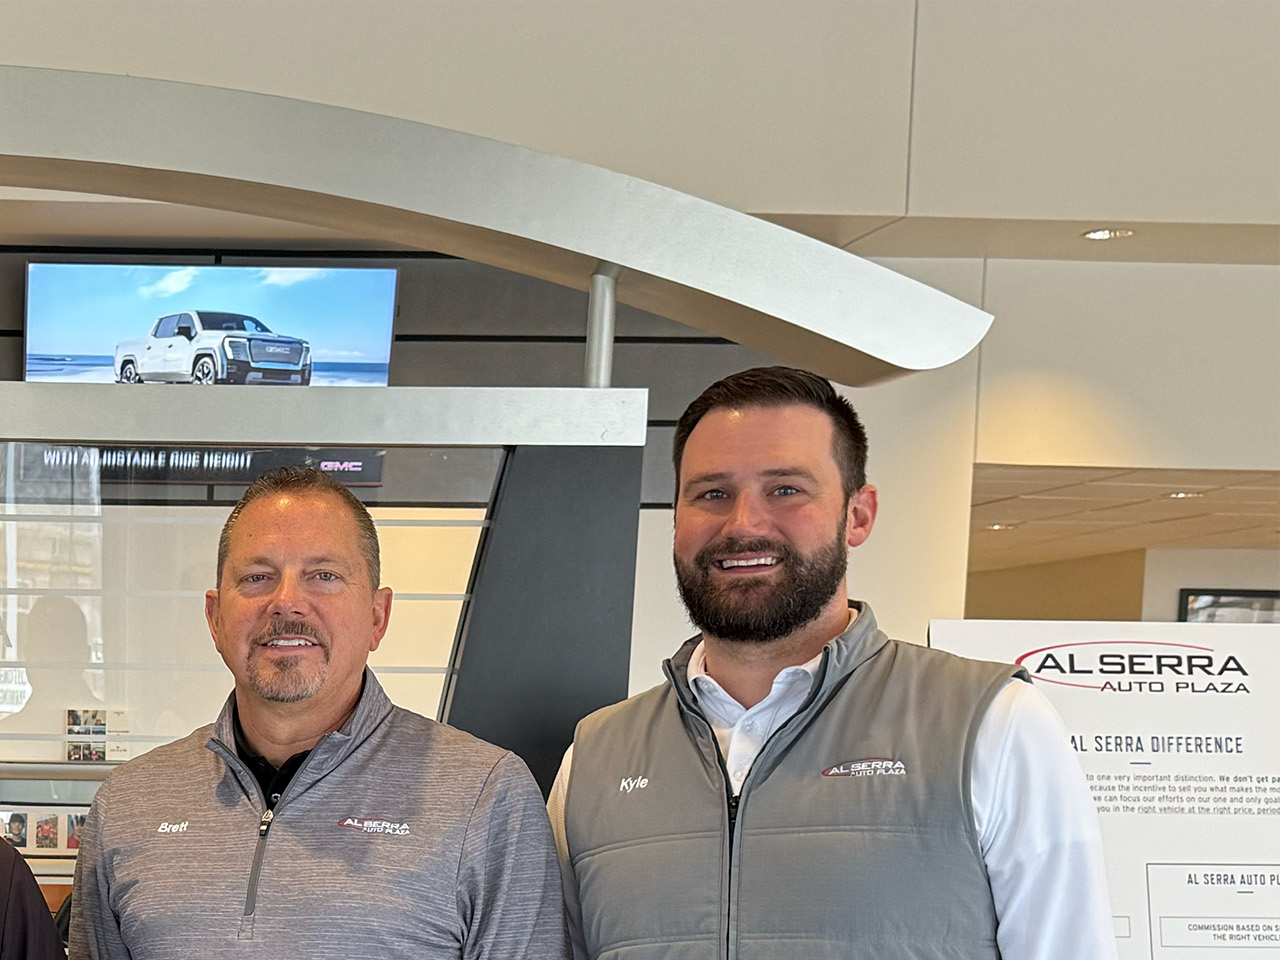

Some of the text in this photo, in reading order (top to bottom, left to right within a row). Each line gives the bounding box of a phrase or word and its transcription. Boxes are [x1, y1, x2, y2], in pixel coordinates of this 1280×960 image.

[321, 461, 363, 471] GMC
[1035, 653, 1249, 676] AL SERRA
[1101, 681, 1250, 694] AUTO PLAZA
[1095, 735, 1144, 753] SERRA
[1151, 736, 1244, 754] DIFFERENCE
[829, 761, 905, 775] AL SERRA
[1133, 774, 1171, 782] important
[1256, 776, 1268, 784] get
[620, 776, 648, 793] Kyle
[1132, 784, 1166, 792] incentive
[1158, 795, 1184, 803] efforts
[1245, 796, 1261, 804] only
[1138, 806, 1155, 814] right
[1159, 806, 1185, 814] vehicle
[1213, 807, 1231, 815] right
[343, 818, 362, 826] AL
[1187, 874, 1199, 885] AL
[1204, 874, 1236, 885] SERRA
[1240, 874, 1266, 885] AUTO
